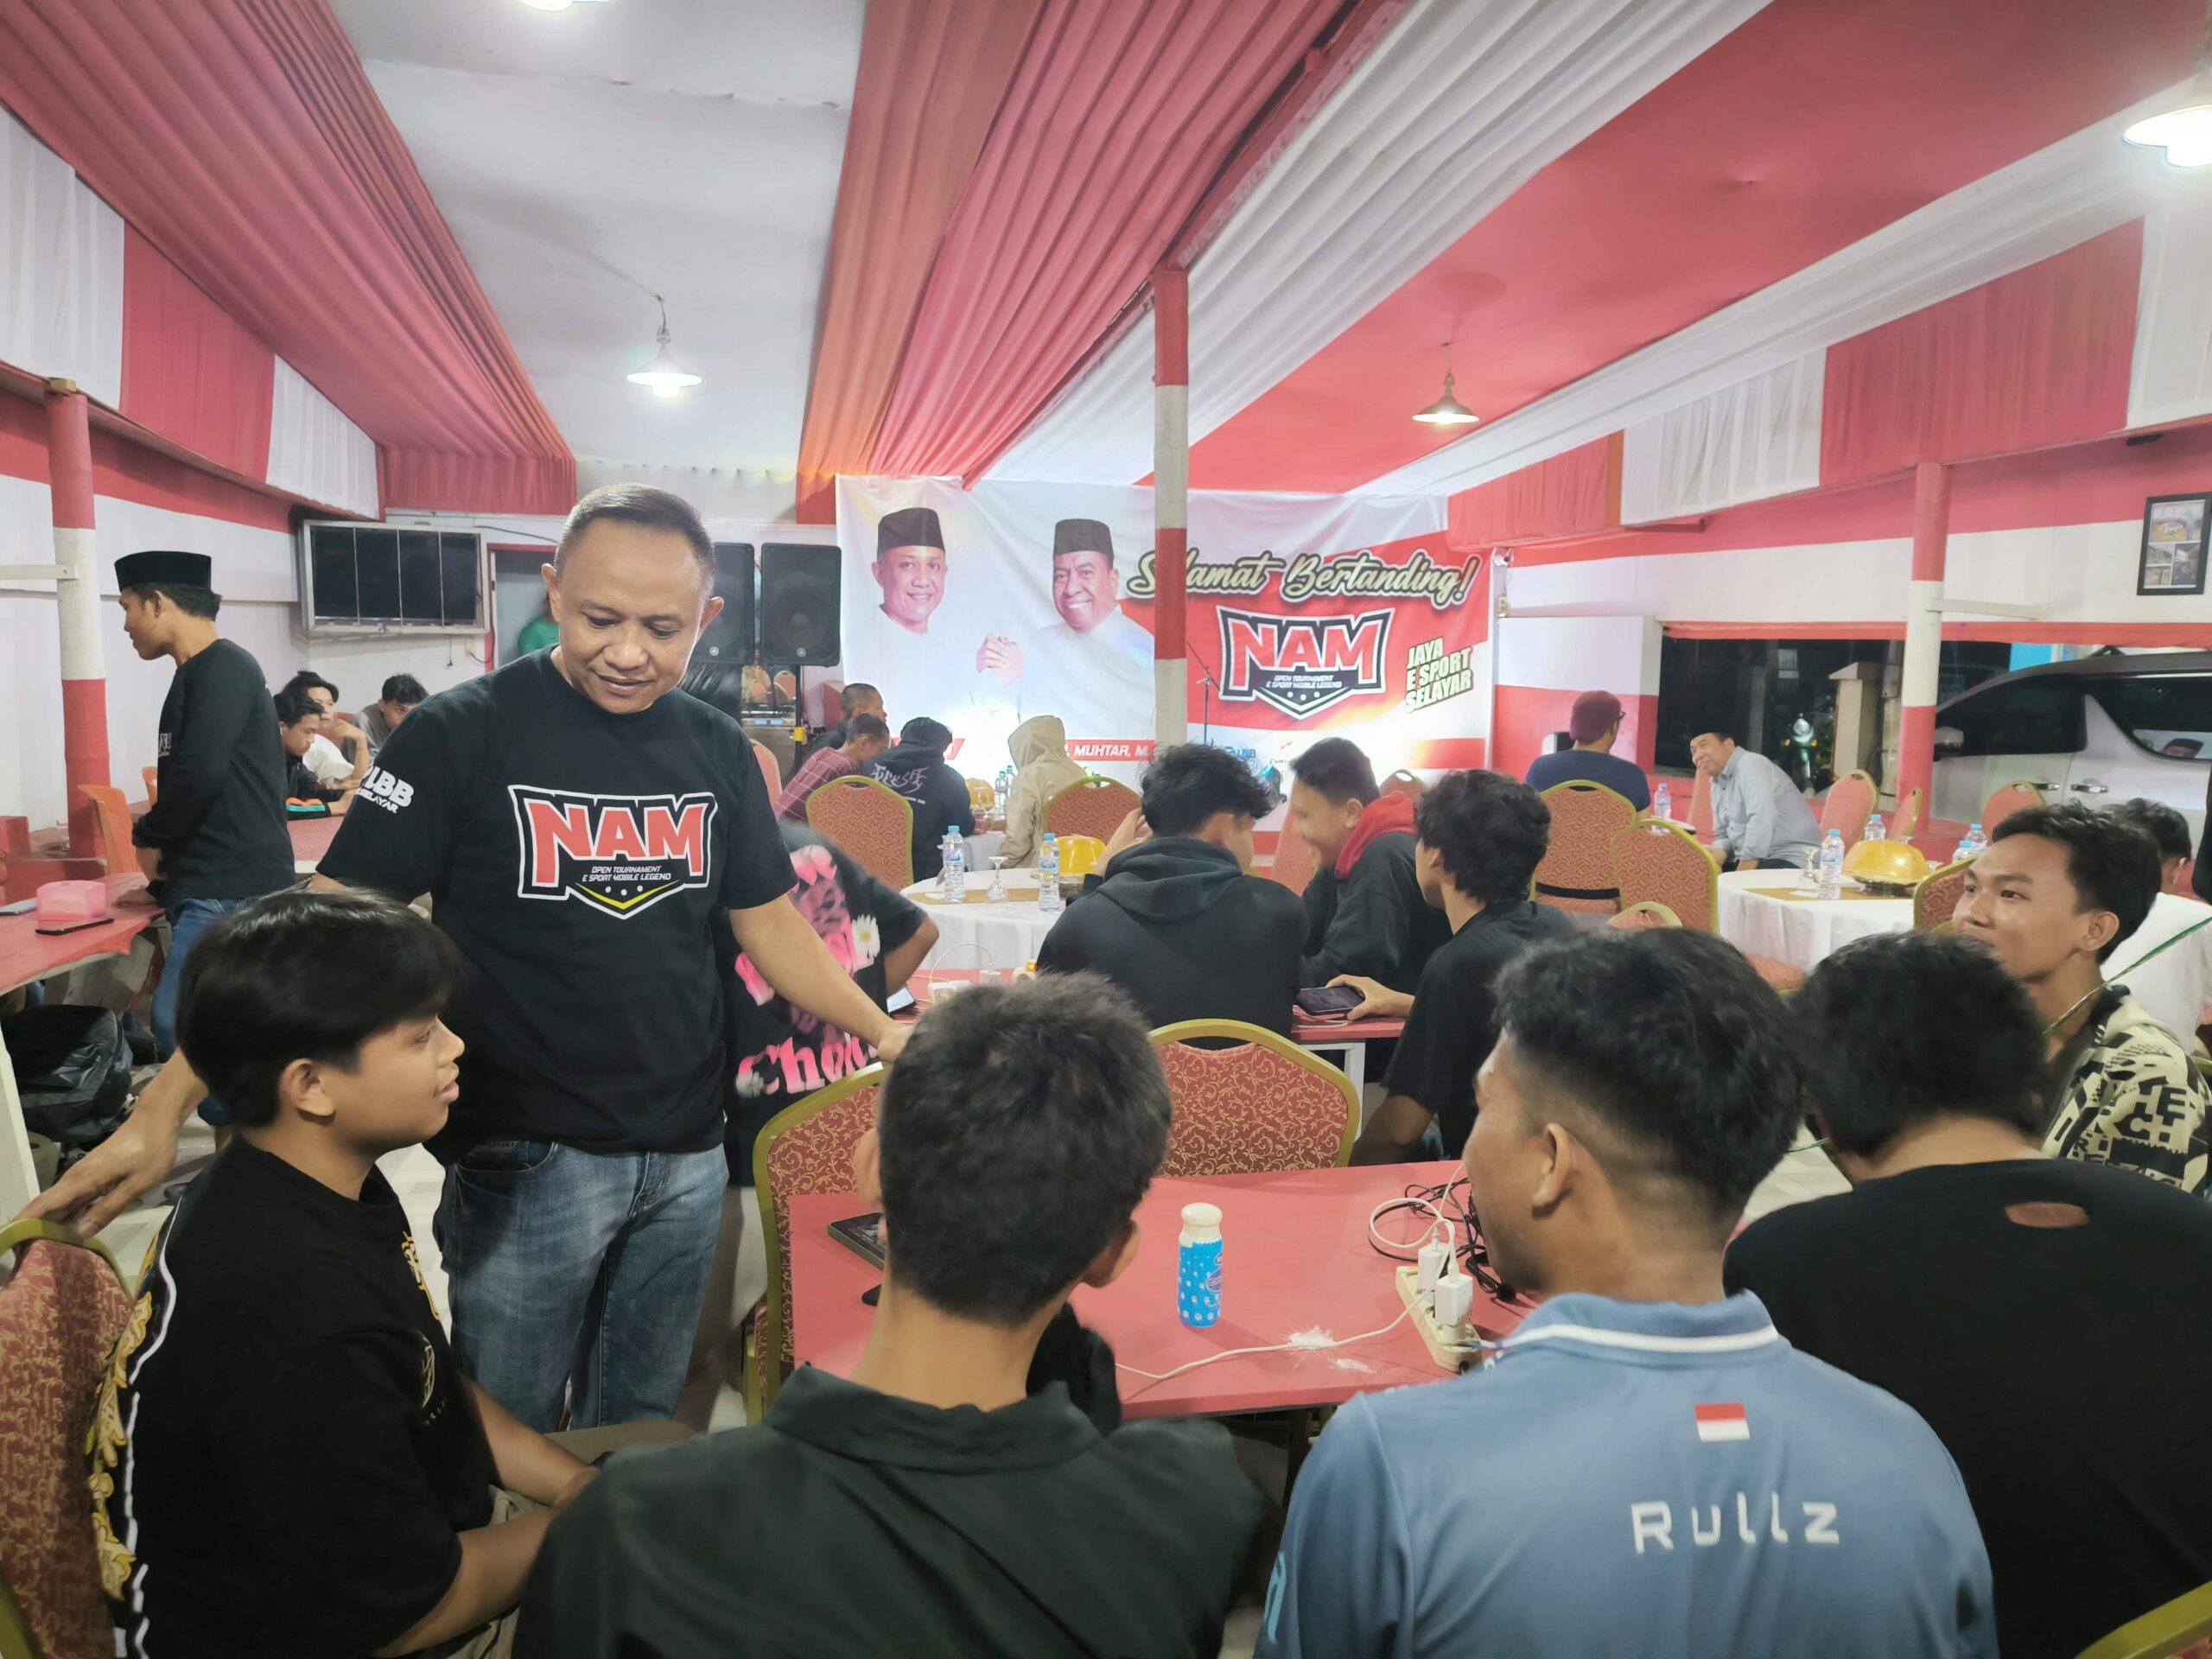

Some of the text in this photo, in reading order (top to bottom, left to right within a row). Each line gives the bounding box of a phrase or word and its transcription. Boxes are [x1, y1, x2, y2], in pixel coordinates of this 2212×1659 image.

[1127, 548, 1481, 607] Slamat Bertanding!
[1230, 615, 1380, 691] NAM
[1407, 637, 1443, 671] JAYA
[1418, 646, 1471, 689] SPORT
[1405, 669, 1473, 714] SELAYAR
[1073, 744, 1132, 758] MUHTAR,
[363, 760, 415, 807] LBB
[523, 798, 709, 888] NAM
[588, 874, 612, 882] SPORT
[1630, 1491, 1840, 1554] Rullz
